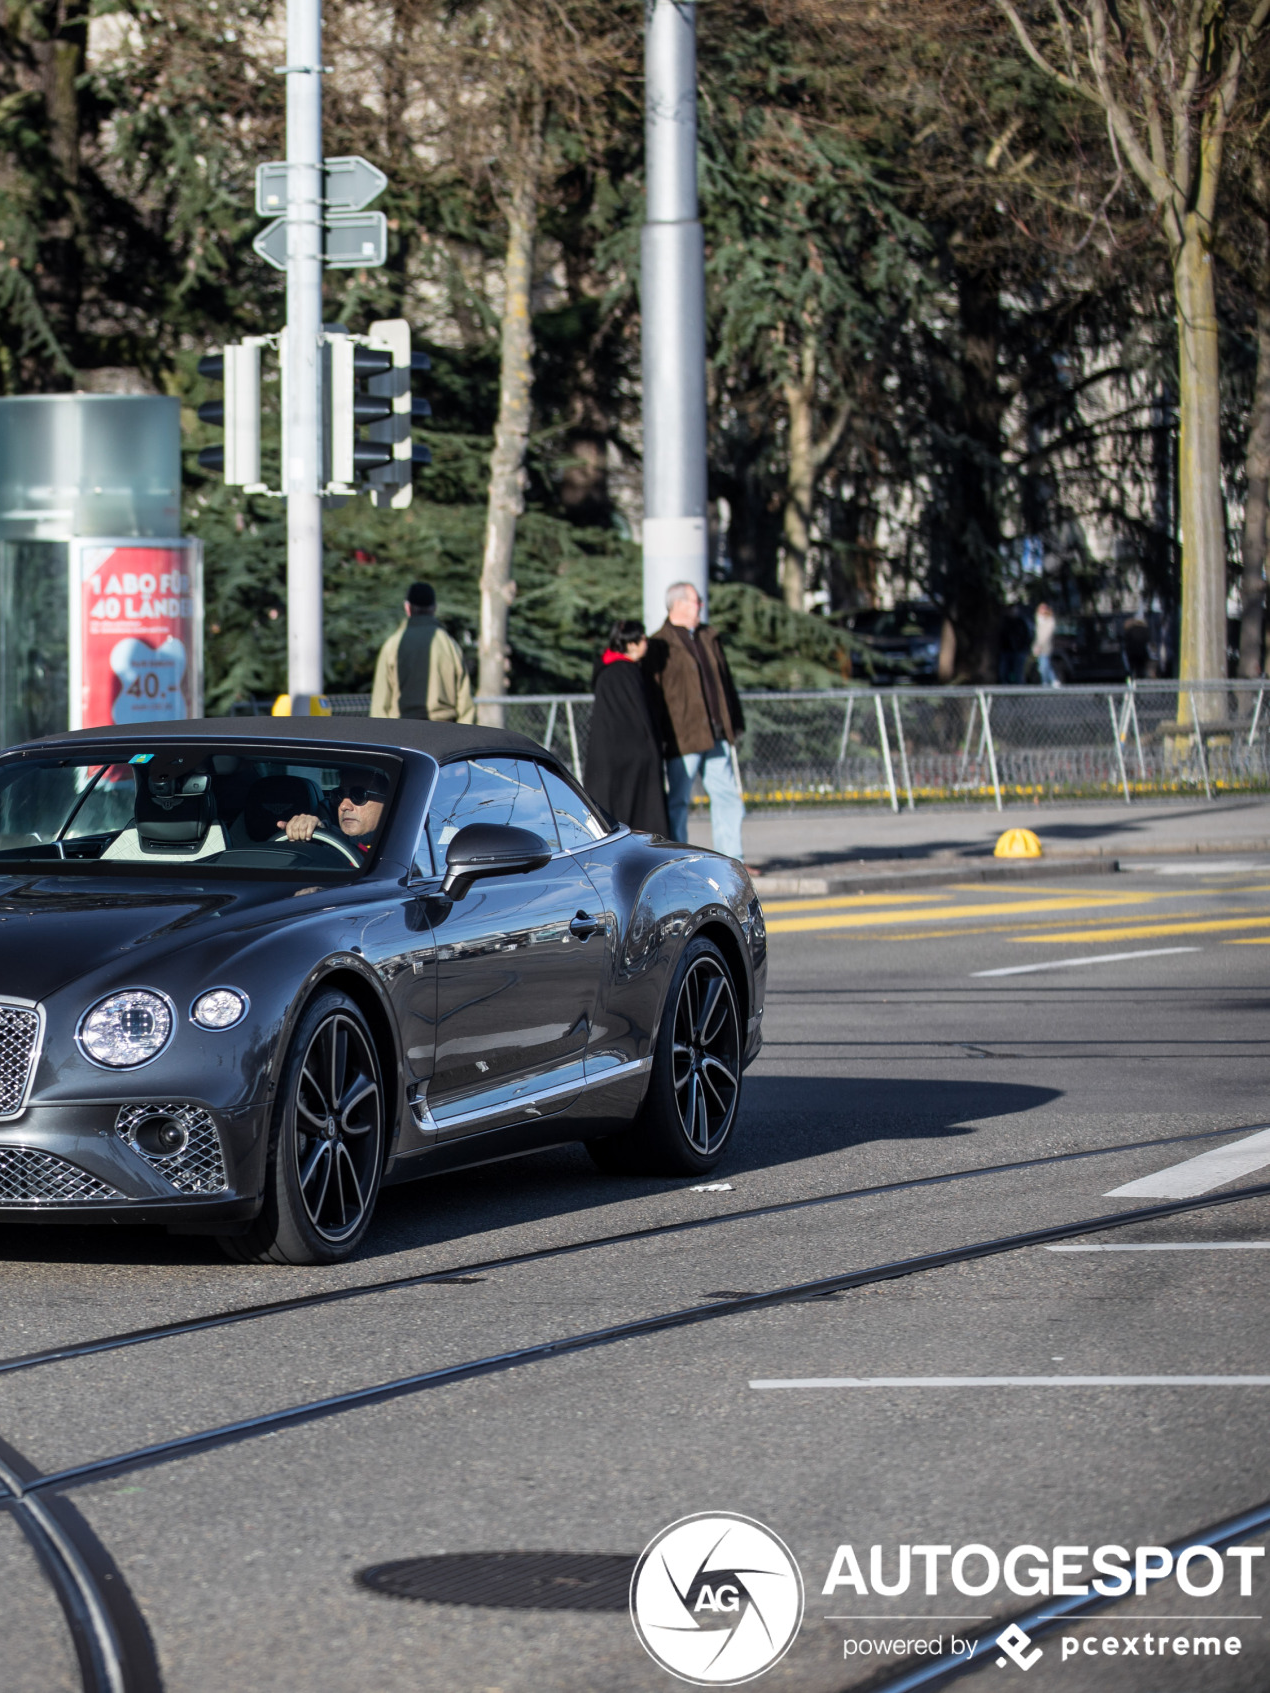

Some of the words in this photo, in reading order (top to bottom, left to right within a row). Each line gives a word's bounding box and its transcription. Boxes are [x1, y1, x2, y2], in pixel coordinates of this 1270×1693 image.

[91, 574, 102, 595] 1
[104, 573, 157, 595] ABO
[90, 597, 121, 619] 40
